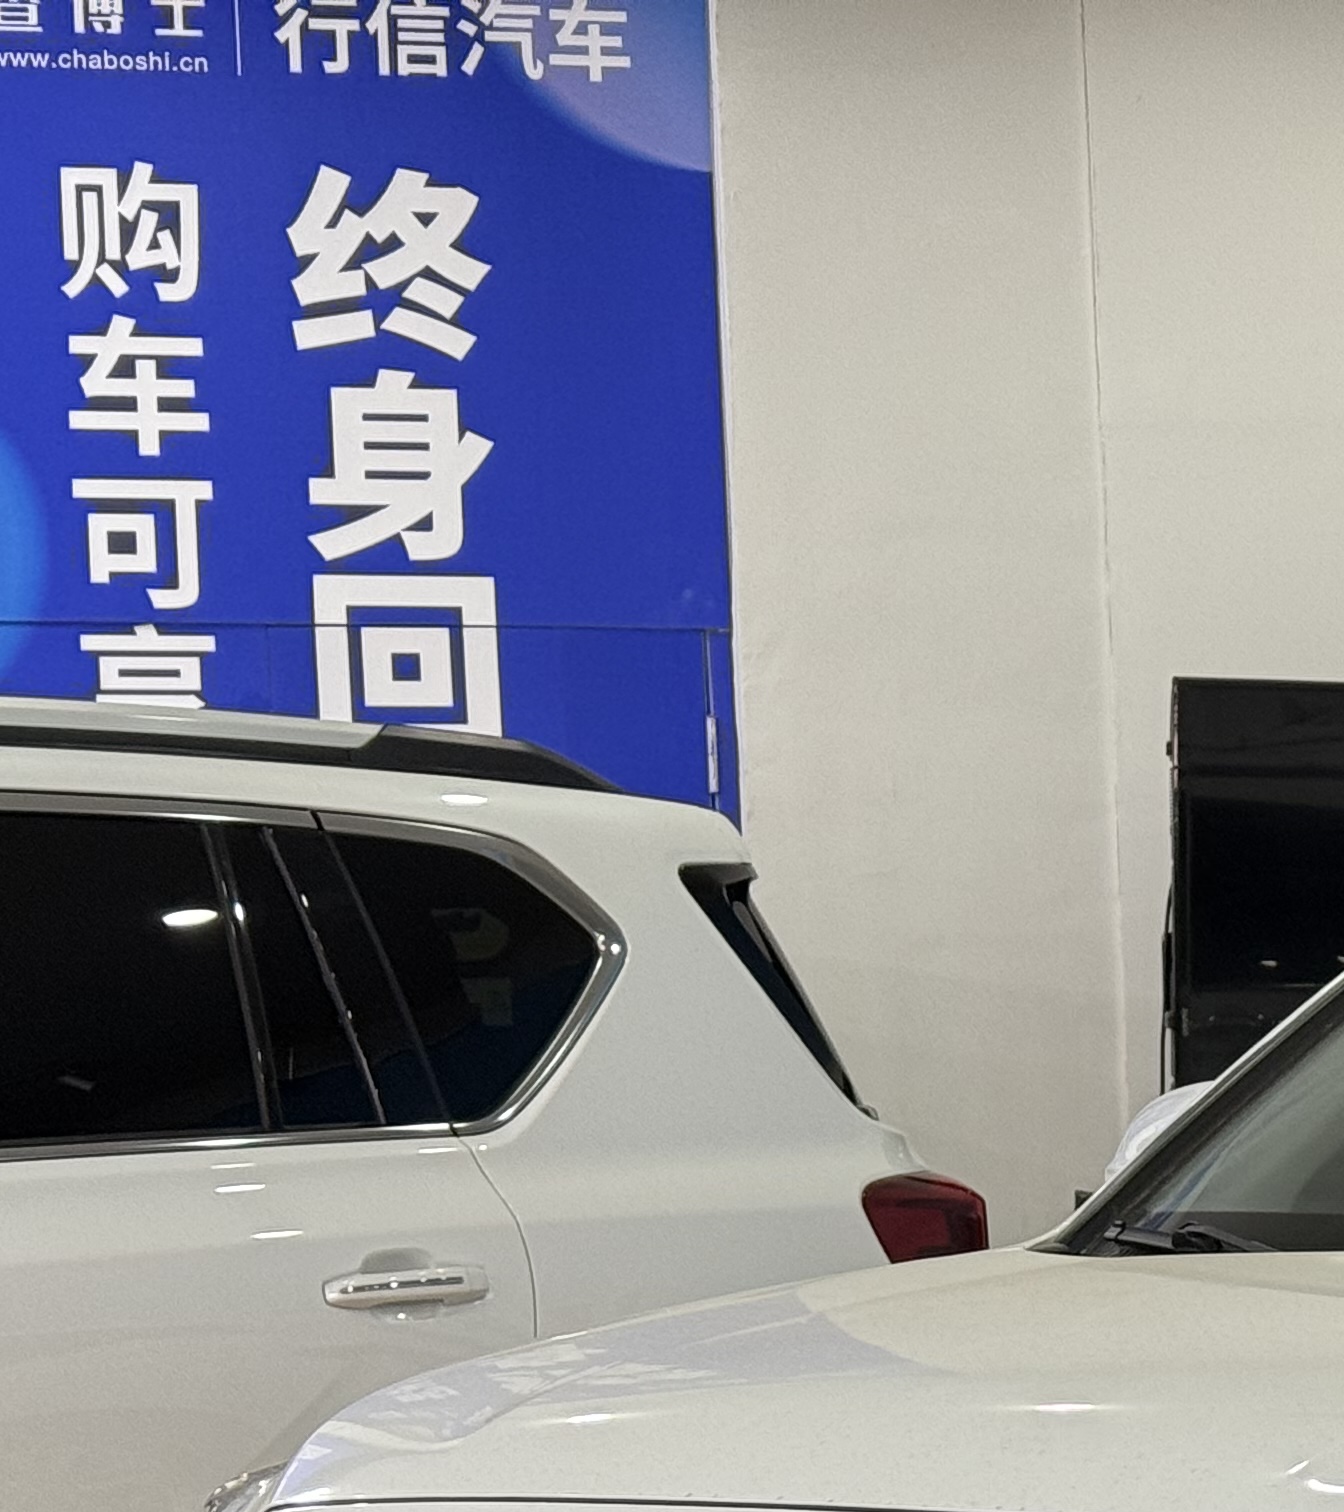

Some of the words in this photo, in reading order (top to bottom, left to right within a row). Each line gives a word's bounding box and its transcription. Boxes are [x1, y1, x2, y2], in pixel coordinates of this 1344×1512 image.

[275, 0, 631, 82] 行信汽车
[286, 164, 503, 738] 终身回
